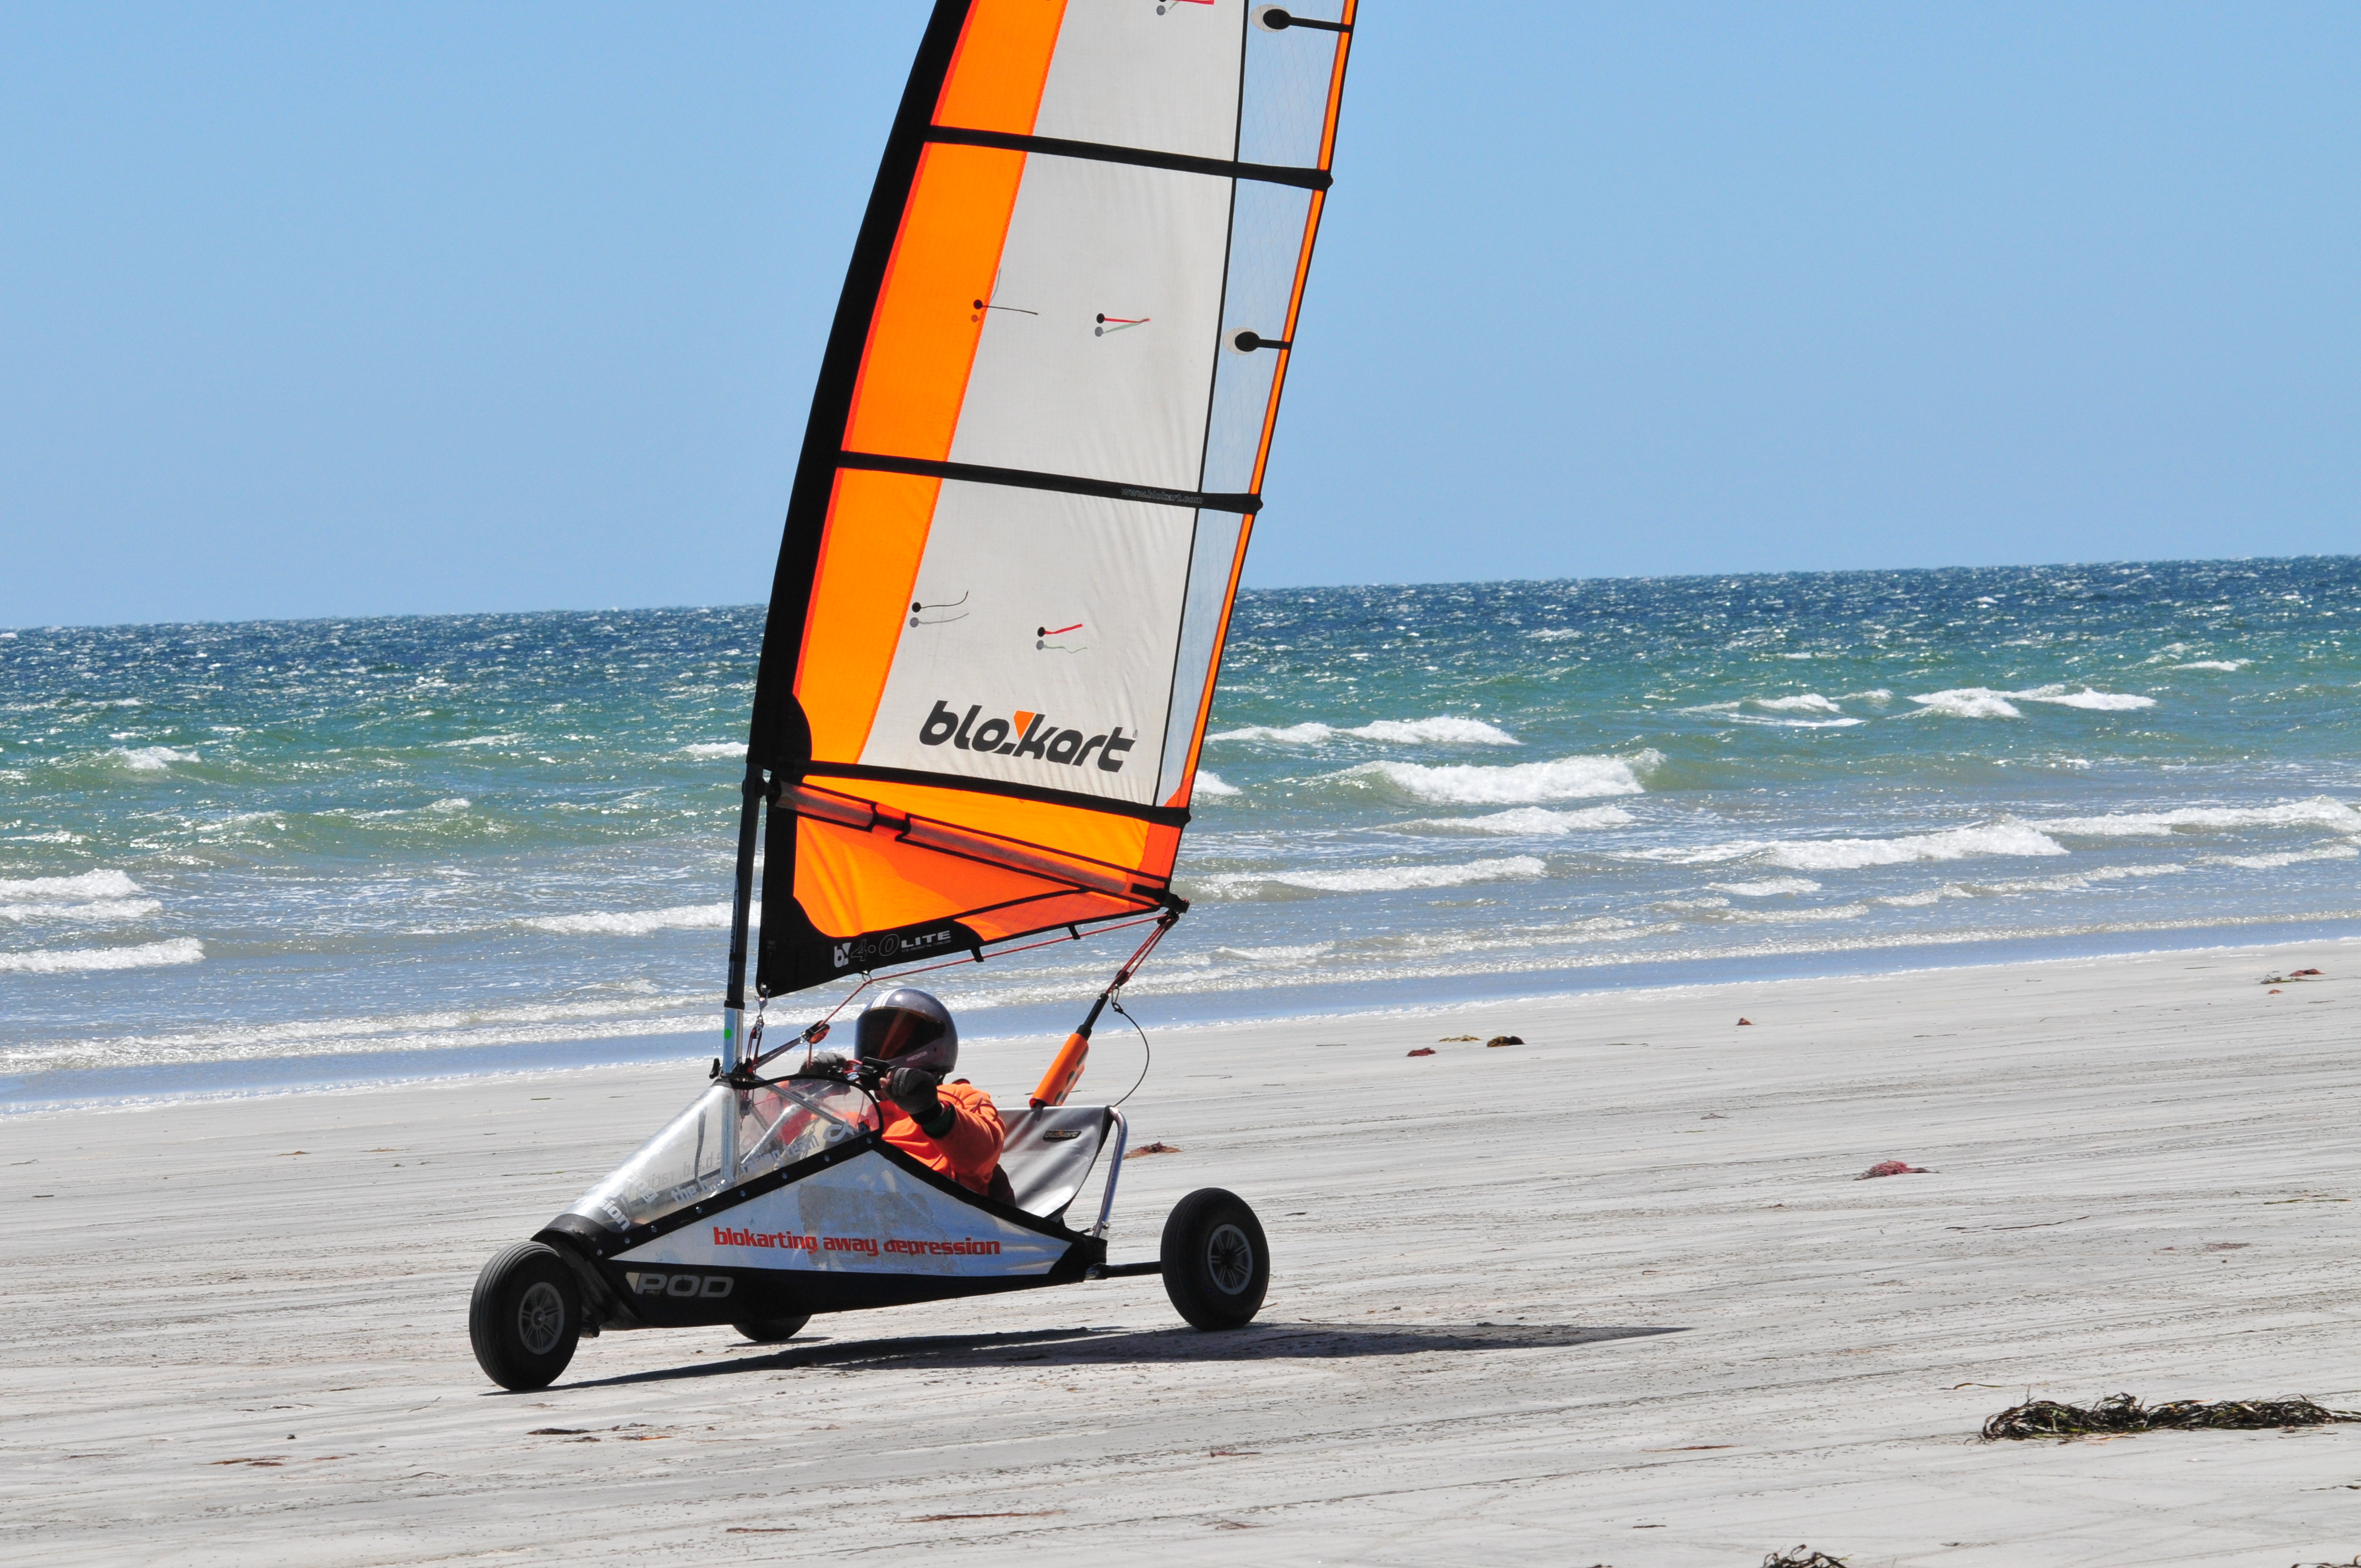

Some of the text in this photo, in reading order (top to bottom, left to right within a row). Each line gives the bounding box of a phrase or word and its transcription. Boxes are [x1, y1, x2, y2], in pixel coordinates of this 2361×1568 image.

[1121, 488, 1204, 504] www.blokart.com
[901, 930, 951, 949] LITE
[906, 1051, 928, 1062] PREDATOR
[671, 1185, 698, 1204] the
[782, 1134, 820, 1158] team
[713, 1227, 1000, 1256] blokarting away depression
[635, 1273, 735, 1298] POD
